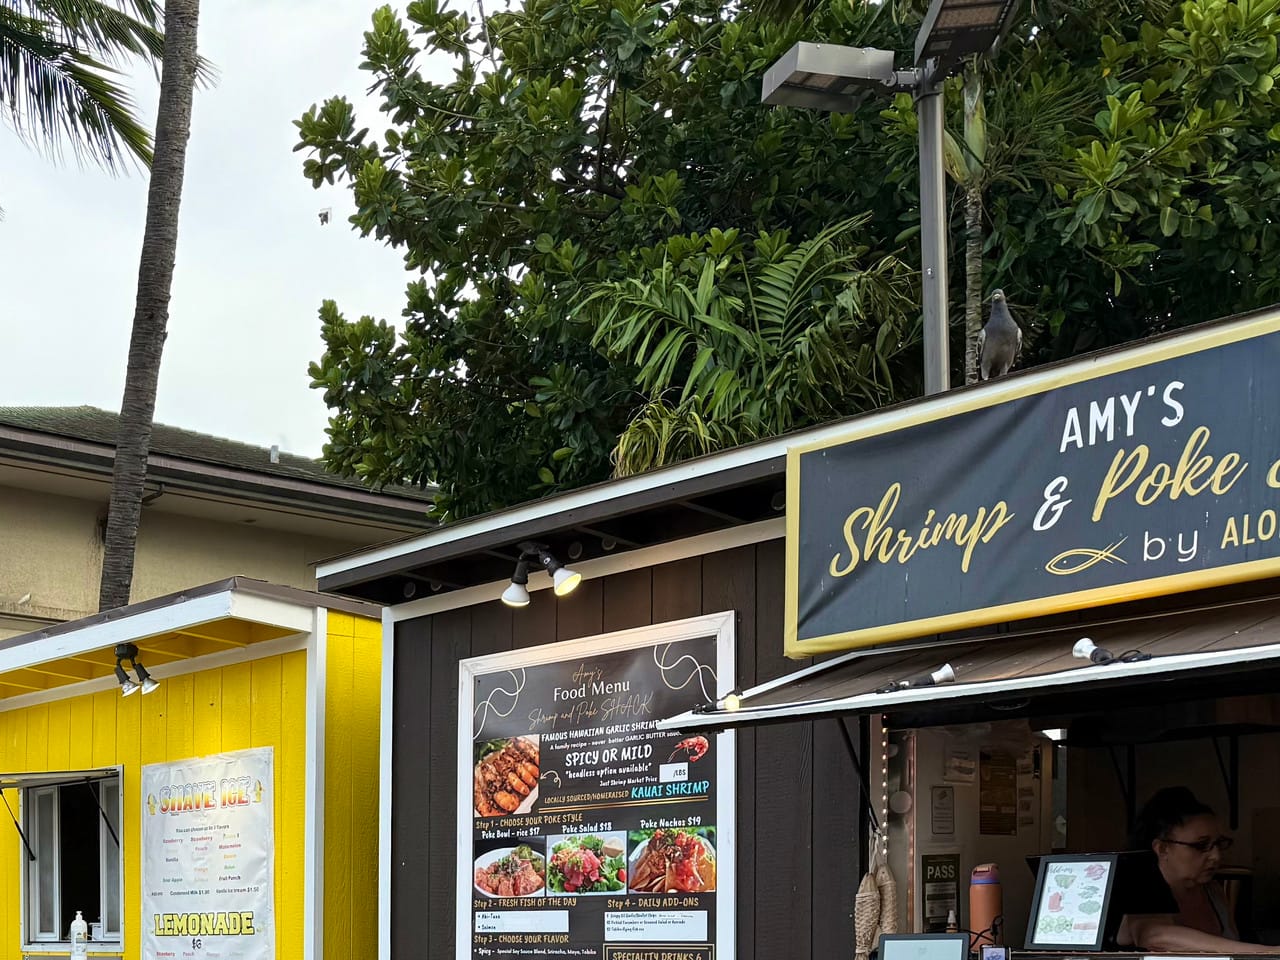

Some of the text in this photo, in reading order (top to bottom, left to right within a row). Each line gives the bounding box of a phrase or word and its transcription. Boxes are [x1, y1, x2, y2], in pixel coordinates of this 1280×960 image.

[1059, 381, 1185, 453] AMY'S
[829, 426, 1248, 578] Shrimp & Poke
[1143, 509, 1280, 565] by ALO
[572, 663, 603, 688] Amy's
[554, 680, 630, 702] Food Menu
[527, 690, 654, 731] Shrimp and Poke SHACK
[541, 731, 568, 742] FAMOUS
[569, 726, 604, 739] HAWAIIAN
[606, 724, 630, 735] GARLIC
[565, 744, 652, 767] SPICY OR MILD
[160, 776, 251, 814] SHAVE ICE
[544, 794, 566, 804] LOCALLY
[631, 785, 663, 799] KAUAI
[666, 781, 709, 797] SHRIMP
[475, 814, 583, 830] Step CHOOSE YOUR POKE STYLE
[496, 829, 511, 838] Bowl
[516, 828, 528, 837] rice
[529, 827, 540, 836] $17
[562, 822, 612, 833] Poke Salad $18
[641, 816, 702, 828] Poke Nachos $19
[927, 865, 955, 879] PASS
[474, 900, 487, 909] Step
[499, 898, 518, 907] FRESH
[520, 898, 535, 906] FISH
[537, 898, 547, 906] OF
[547, 898, 561, 906] THE
[563, 897, 577, 906] DAY
[607, 899, 624, 909] Step
[638, 898, 660, 908] DAILY
[662, 897, 699, 907] ADD-ONS
[154, 911, 255, 936] LEMONADE
[474, 935, 487, 945] Step
[499, 935, 522, 943] CHOOSE
[524, 935, 541, 944] YOUR
[543, 935, 569, 943] FLAVOR
